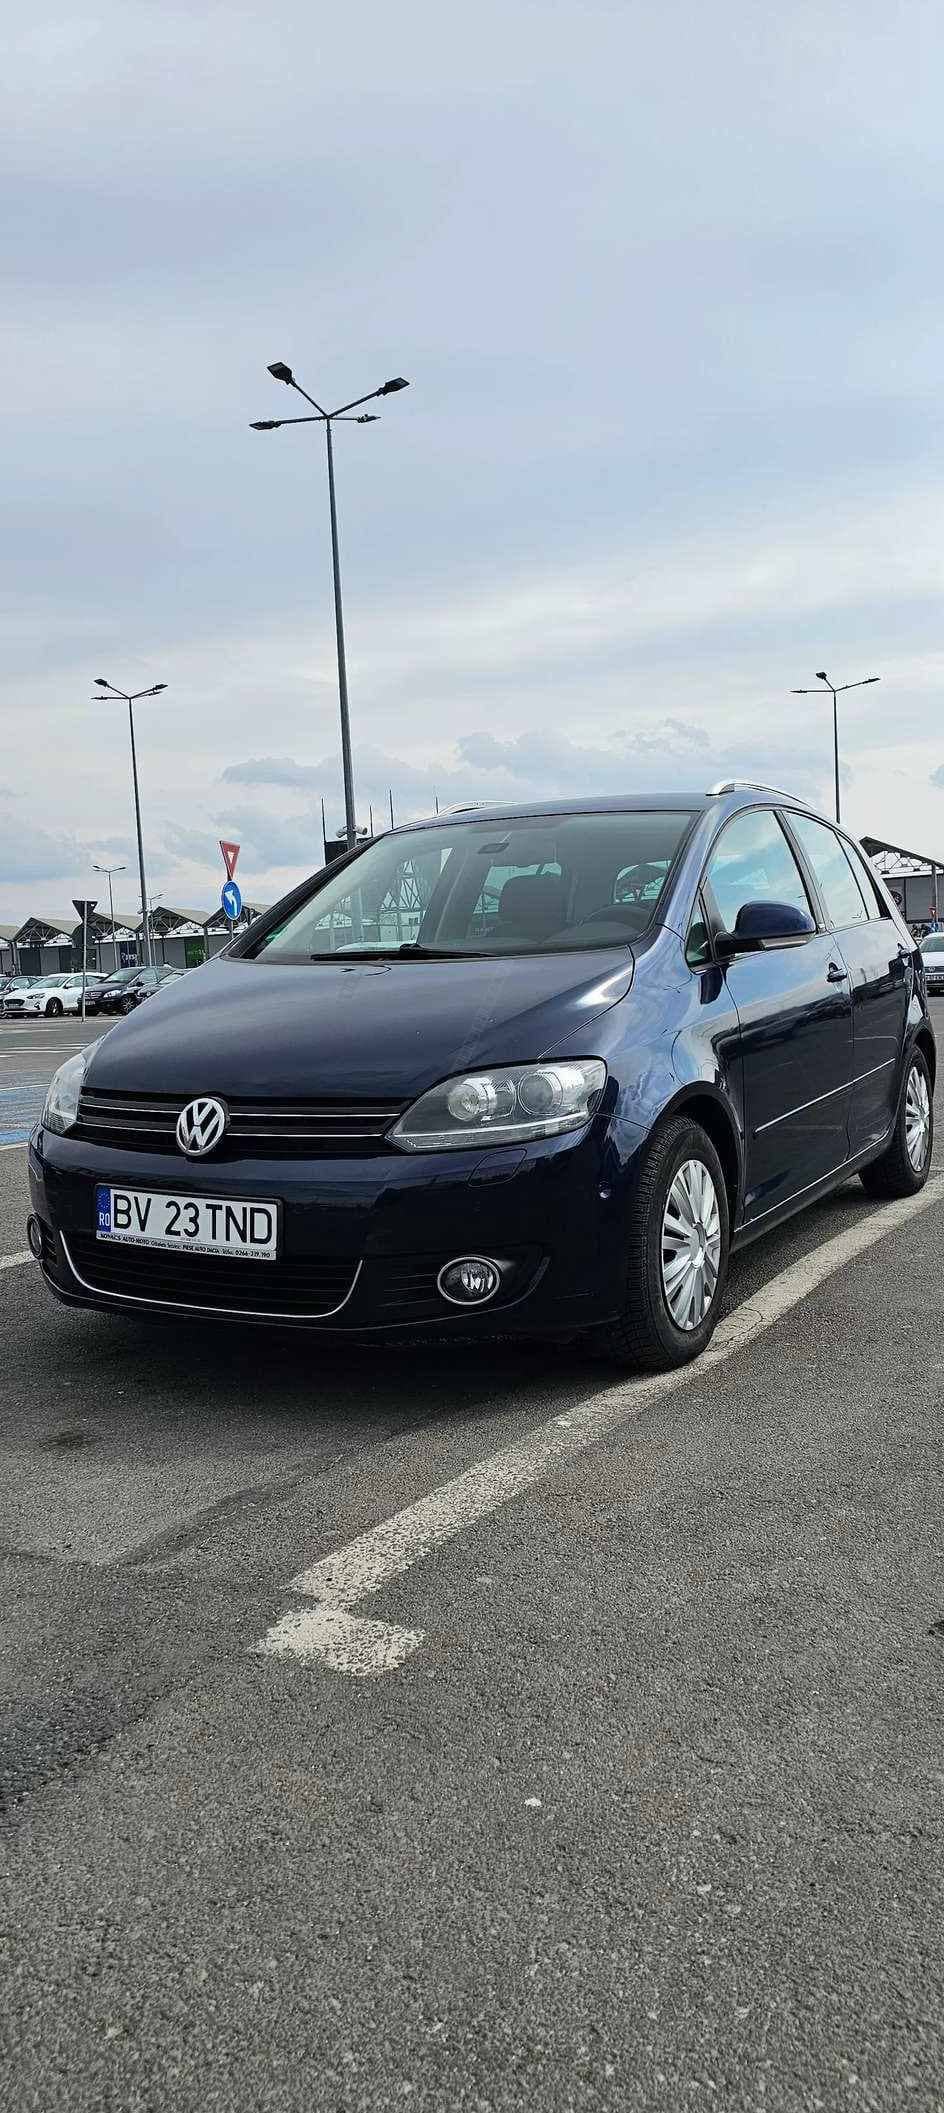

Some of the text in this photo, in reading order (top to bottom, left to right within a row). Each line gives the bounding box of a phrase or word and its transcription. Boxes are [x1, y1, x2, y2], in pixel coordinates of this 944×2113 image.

[100, 1212, 111, 1227] RO
[113, 1194, 272, 1244] BV 23 TND
